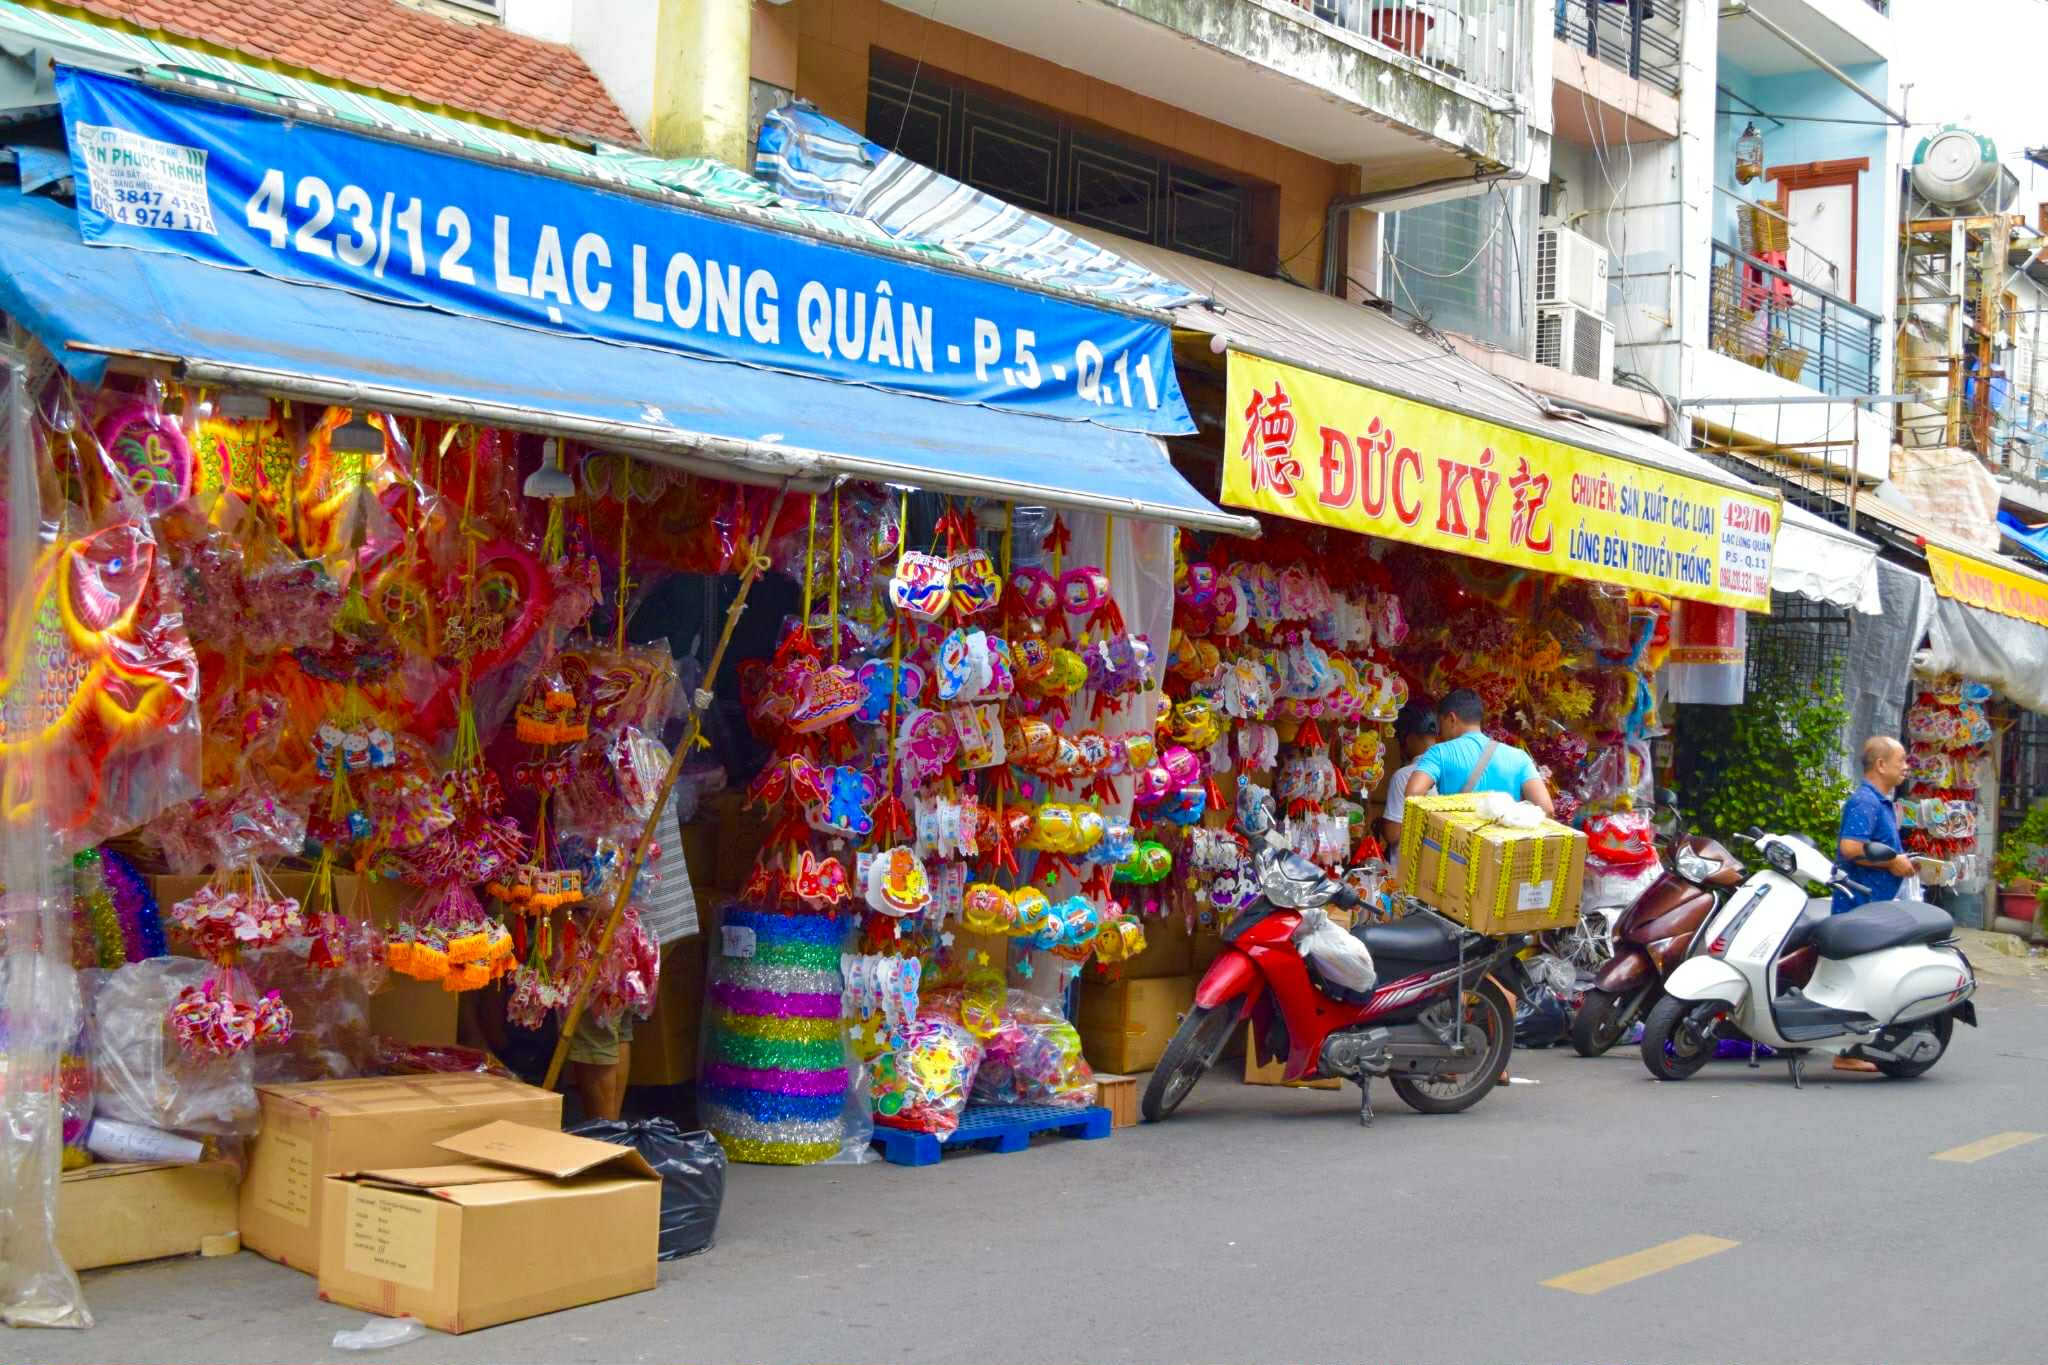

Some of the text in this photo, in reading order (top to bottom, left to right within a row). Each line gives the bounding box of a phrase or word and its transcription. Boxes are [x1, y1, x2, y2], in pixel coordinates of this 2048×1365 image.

[135, 207, 174, 229] 974
[184, 213, 214, 232] 174
[246, 168, 476, 287] 423/12
[494, 214, 612, 324] LẠC
[632, 244, 780, 345] LONG
[798, 279, 934, 374] QUÂN
[974, 317, 1042, 389] P.5
[1075, 338, 1159, 411] Q.11
[1241, 380, 1553, 555] 德 ĐỨC KÝ 記
[1571, 472, 1715, 540] CHUYÊN: SẢN XUẤT CÁC LOẠI
[1723, 502, 1771, 535] 423/10
[1603, 528, 1628, 570] ĐÈN
[1631, 535, 1672, 578] TRUYỀN
[1675, 544, 1711, 587] THỐNG
